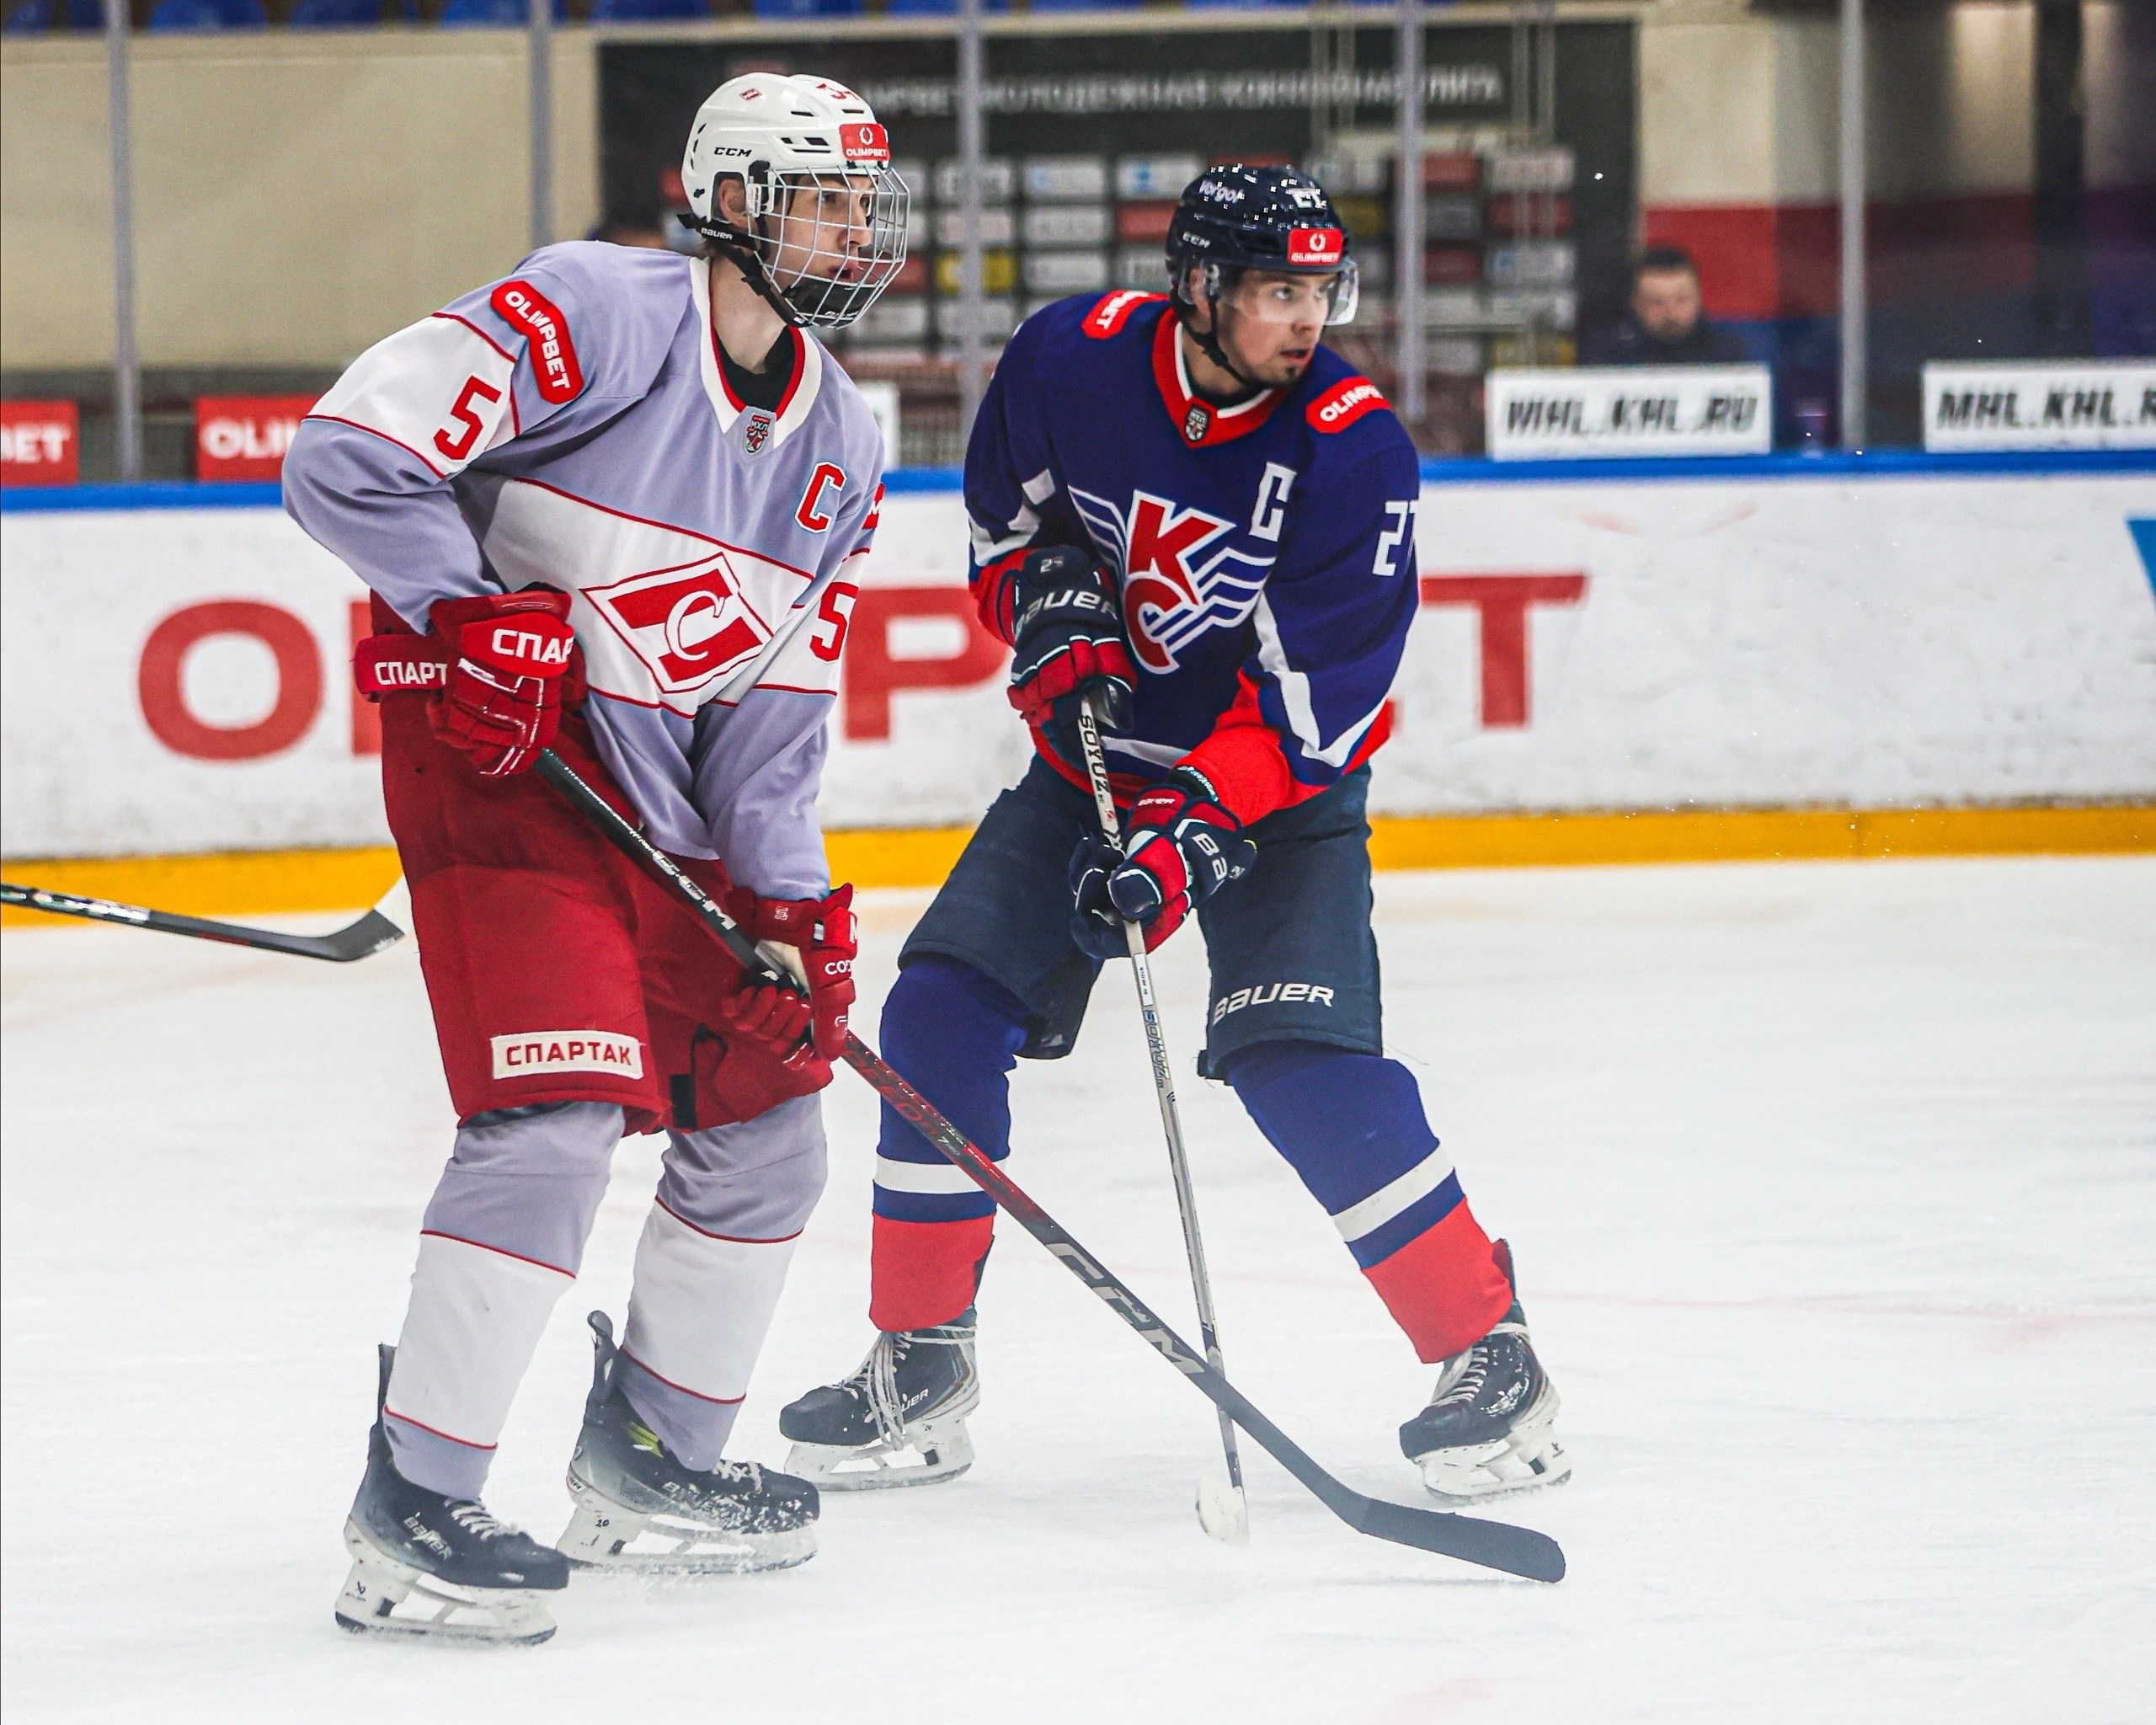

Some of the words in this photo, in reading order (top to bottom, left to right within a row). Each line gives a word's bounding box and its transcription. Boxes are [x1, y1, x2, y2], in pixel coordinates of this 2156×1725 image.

[714, 147, 753, 158] CCM
[846, 148, 887, 158] OLIMPBET
[200, 416, 300, 459] OLI
[433, 375, 504, 461] 5
[809, 582, 859, 662] 5
[1080, 714, 1112, 793] SOYUZ
[653, 850, 737, 930] CCM
[1192, 833, 1228, 895] BA
[1213, 983, 1334, 1026] BAUER
[506, 1041, 632, 1066] СПАРТАК
[1046, 1242, 1206, 1374] CCM
[902, 1388, 930, 1413] UER
